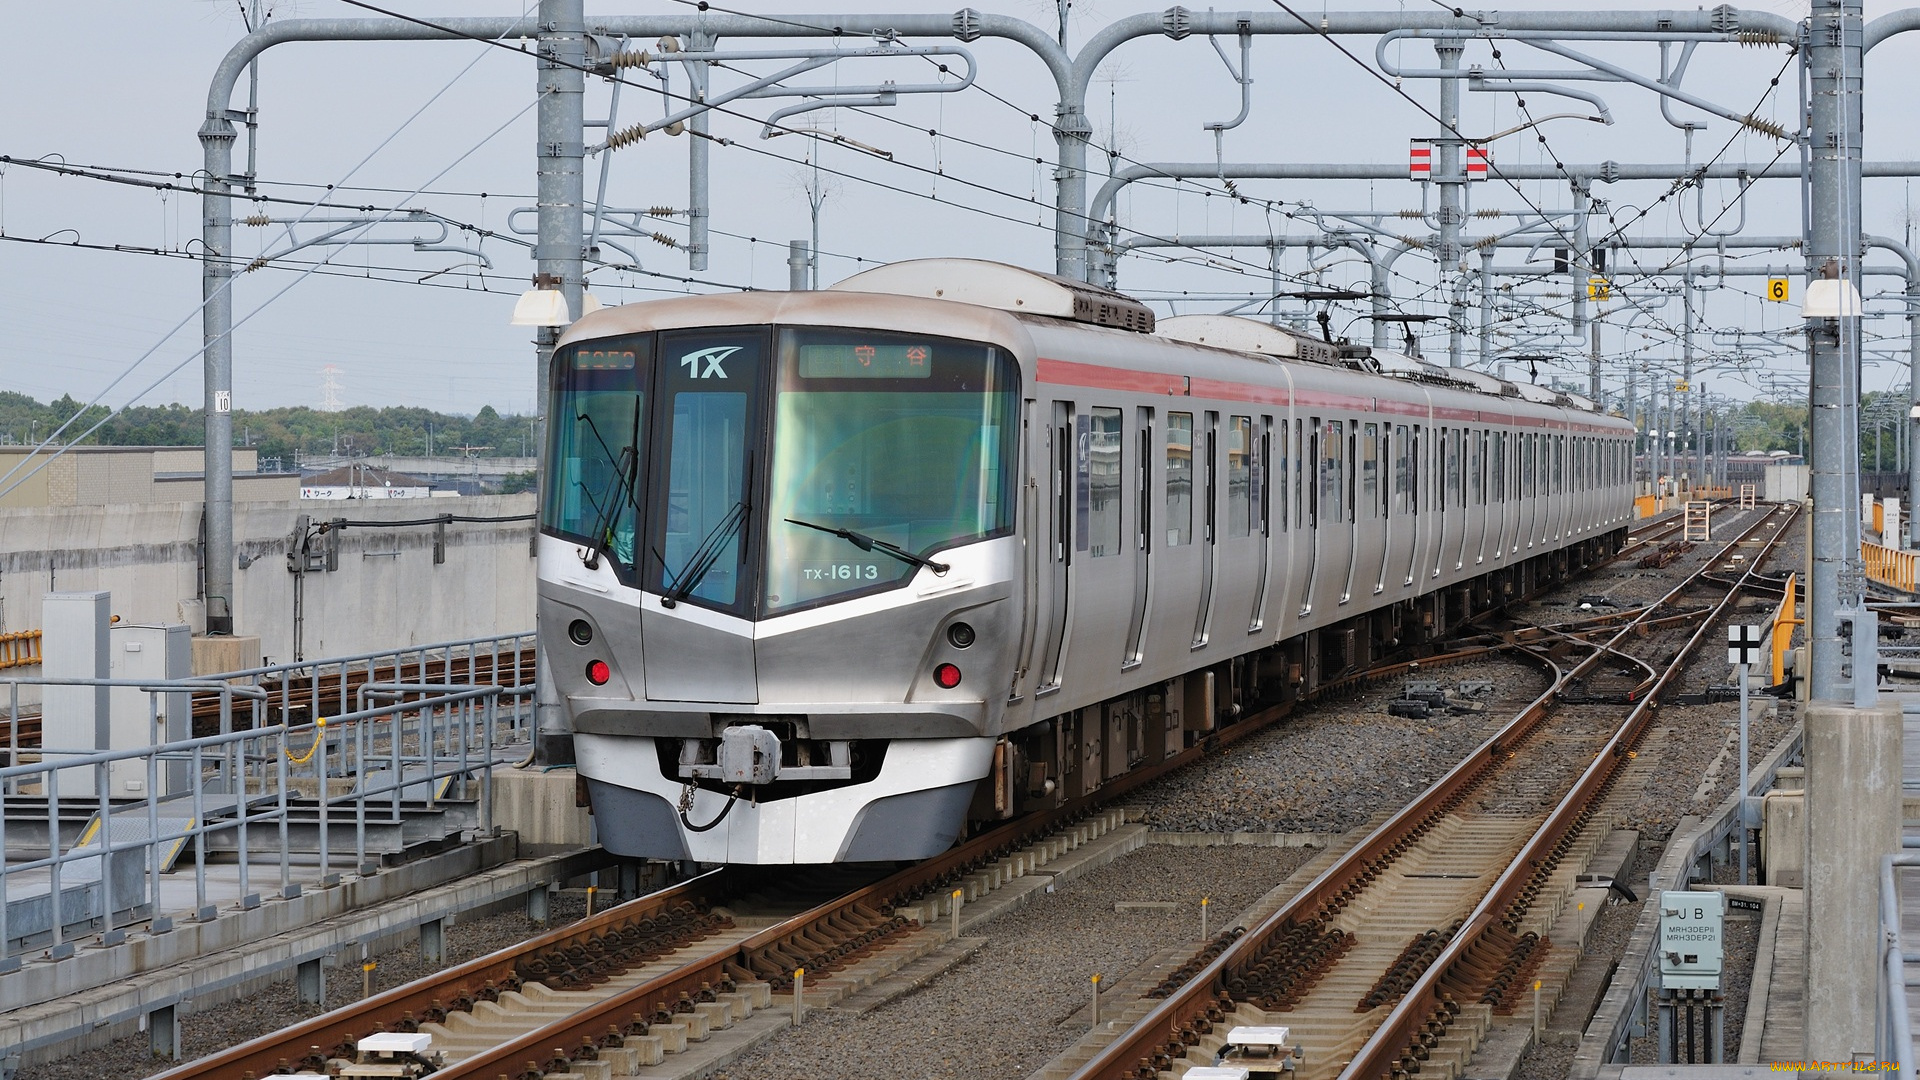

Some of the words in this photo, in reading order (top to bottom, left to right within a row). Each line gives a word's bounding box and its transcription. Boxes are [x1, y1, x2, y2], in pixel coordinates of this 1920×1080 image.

[1773, 281, 1784, 298] 6
[681, 346, 744, 379] TX
[220, 398, 229, 411] 10
[803, 565, 878, 580] TX-1613
